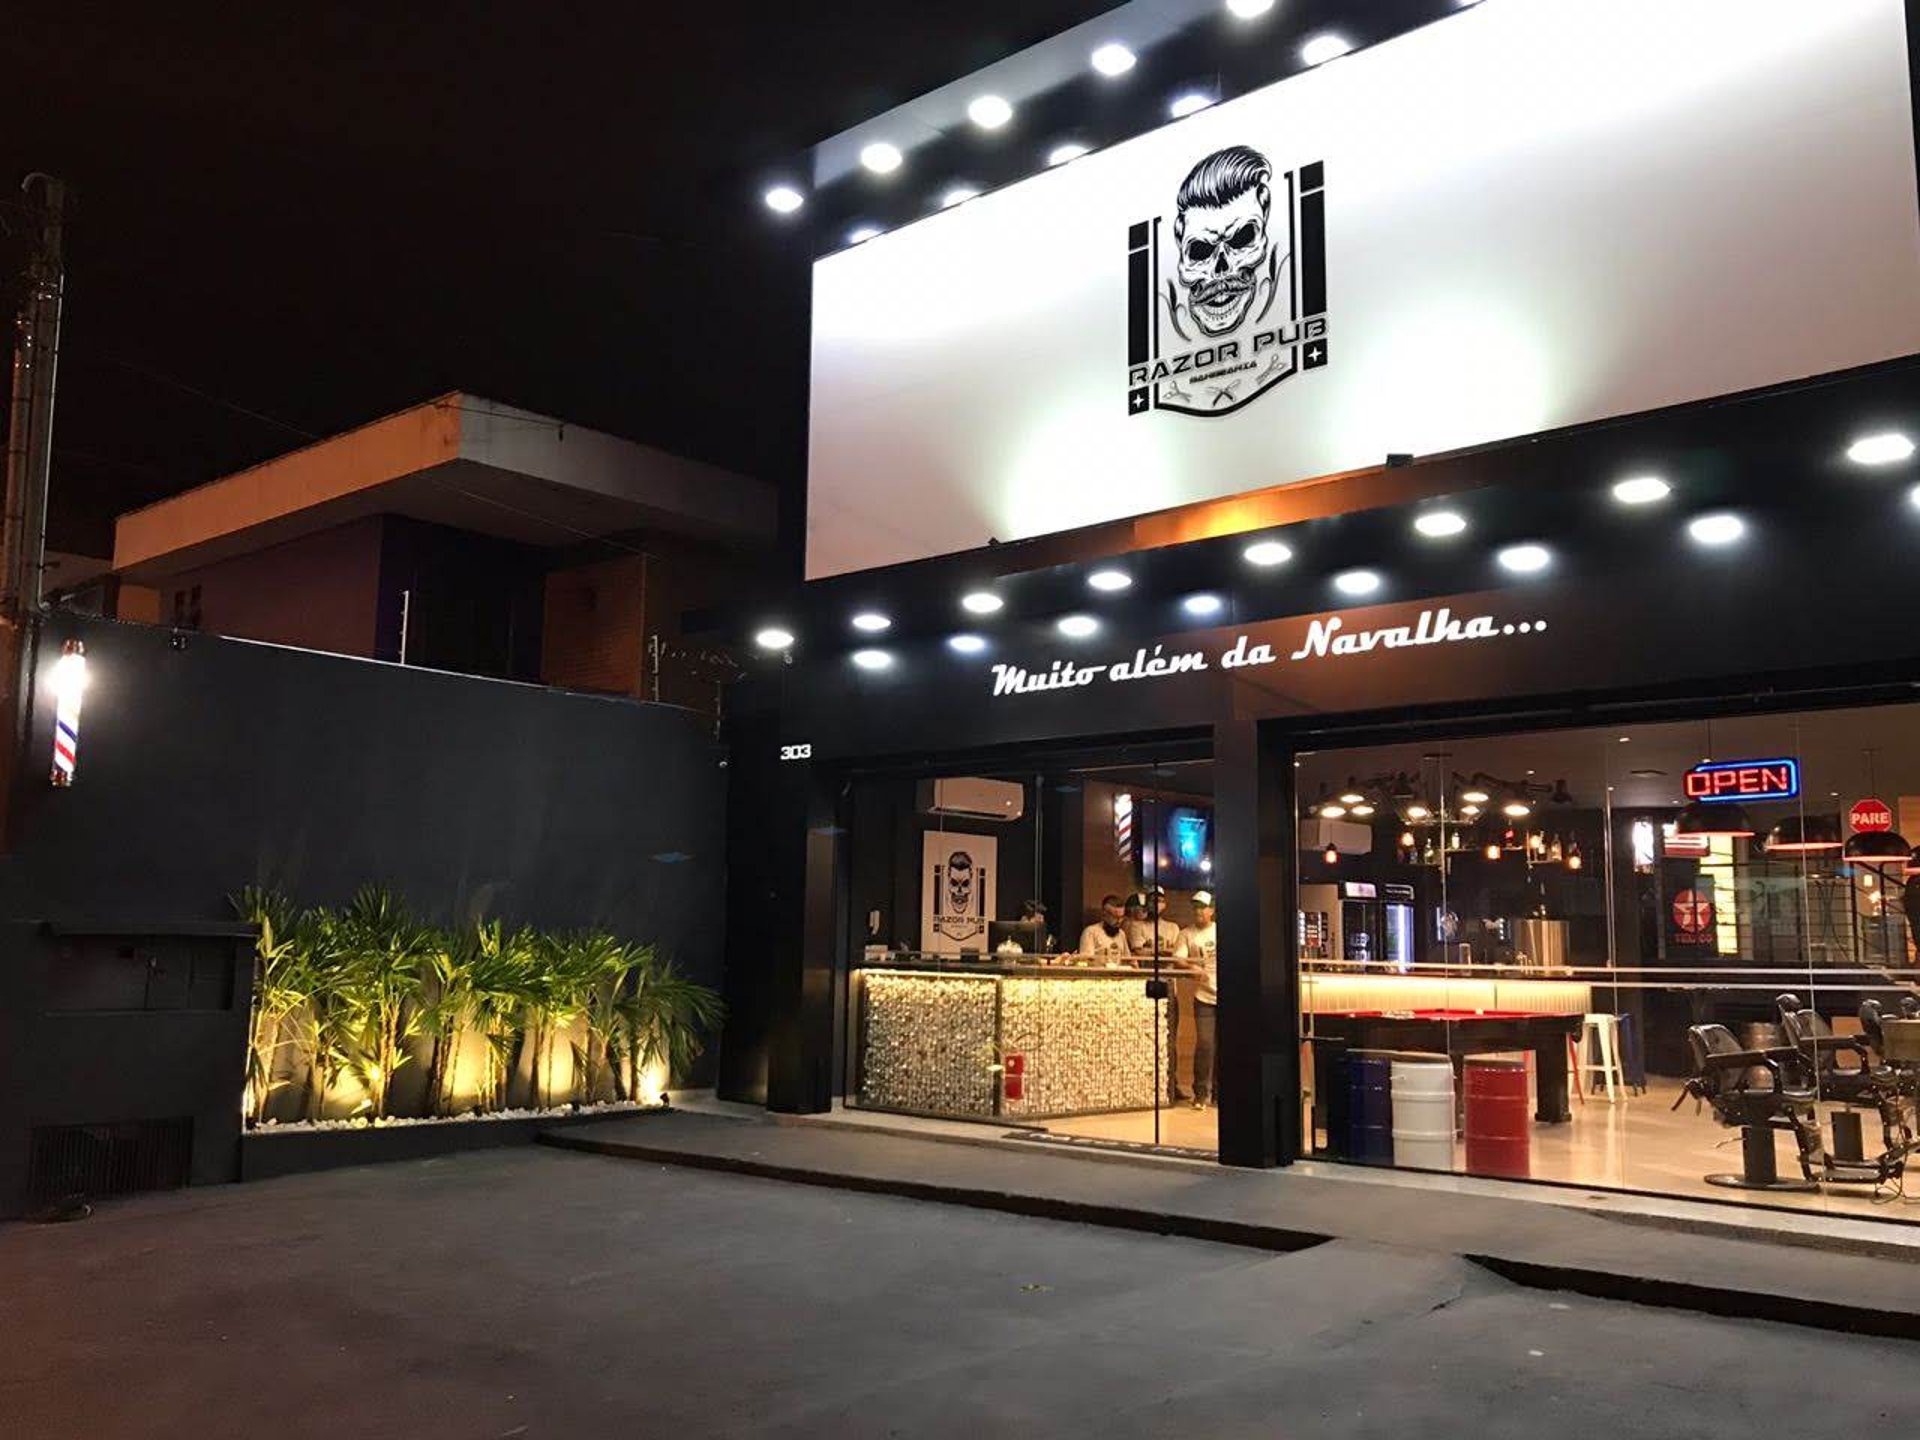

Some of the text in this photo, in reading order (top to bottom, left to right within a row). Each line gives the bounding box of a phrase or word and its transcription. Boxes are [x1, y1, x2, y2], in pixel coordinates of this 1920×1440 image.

[1129, 341, 1240, 386] RAZOR
[1253, 317, 1327, 352] PUB
[991, 660, 1107, 697] Muito
[1109, 644, 1209, 682] além
[1221, 635, 1277, 669] da
[780, 744, 812, 760] 303
[1686, 766, 1788, 796] OPEN
[1851, 811, 1890, 825] PARE
